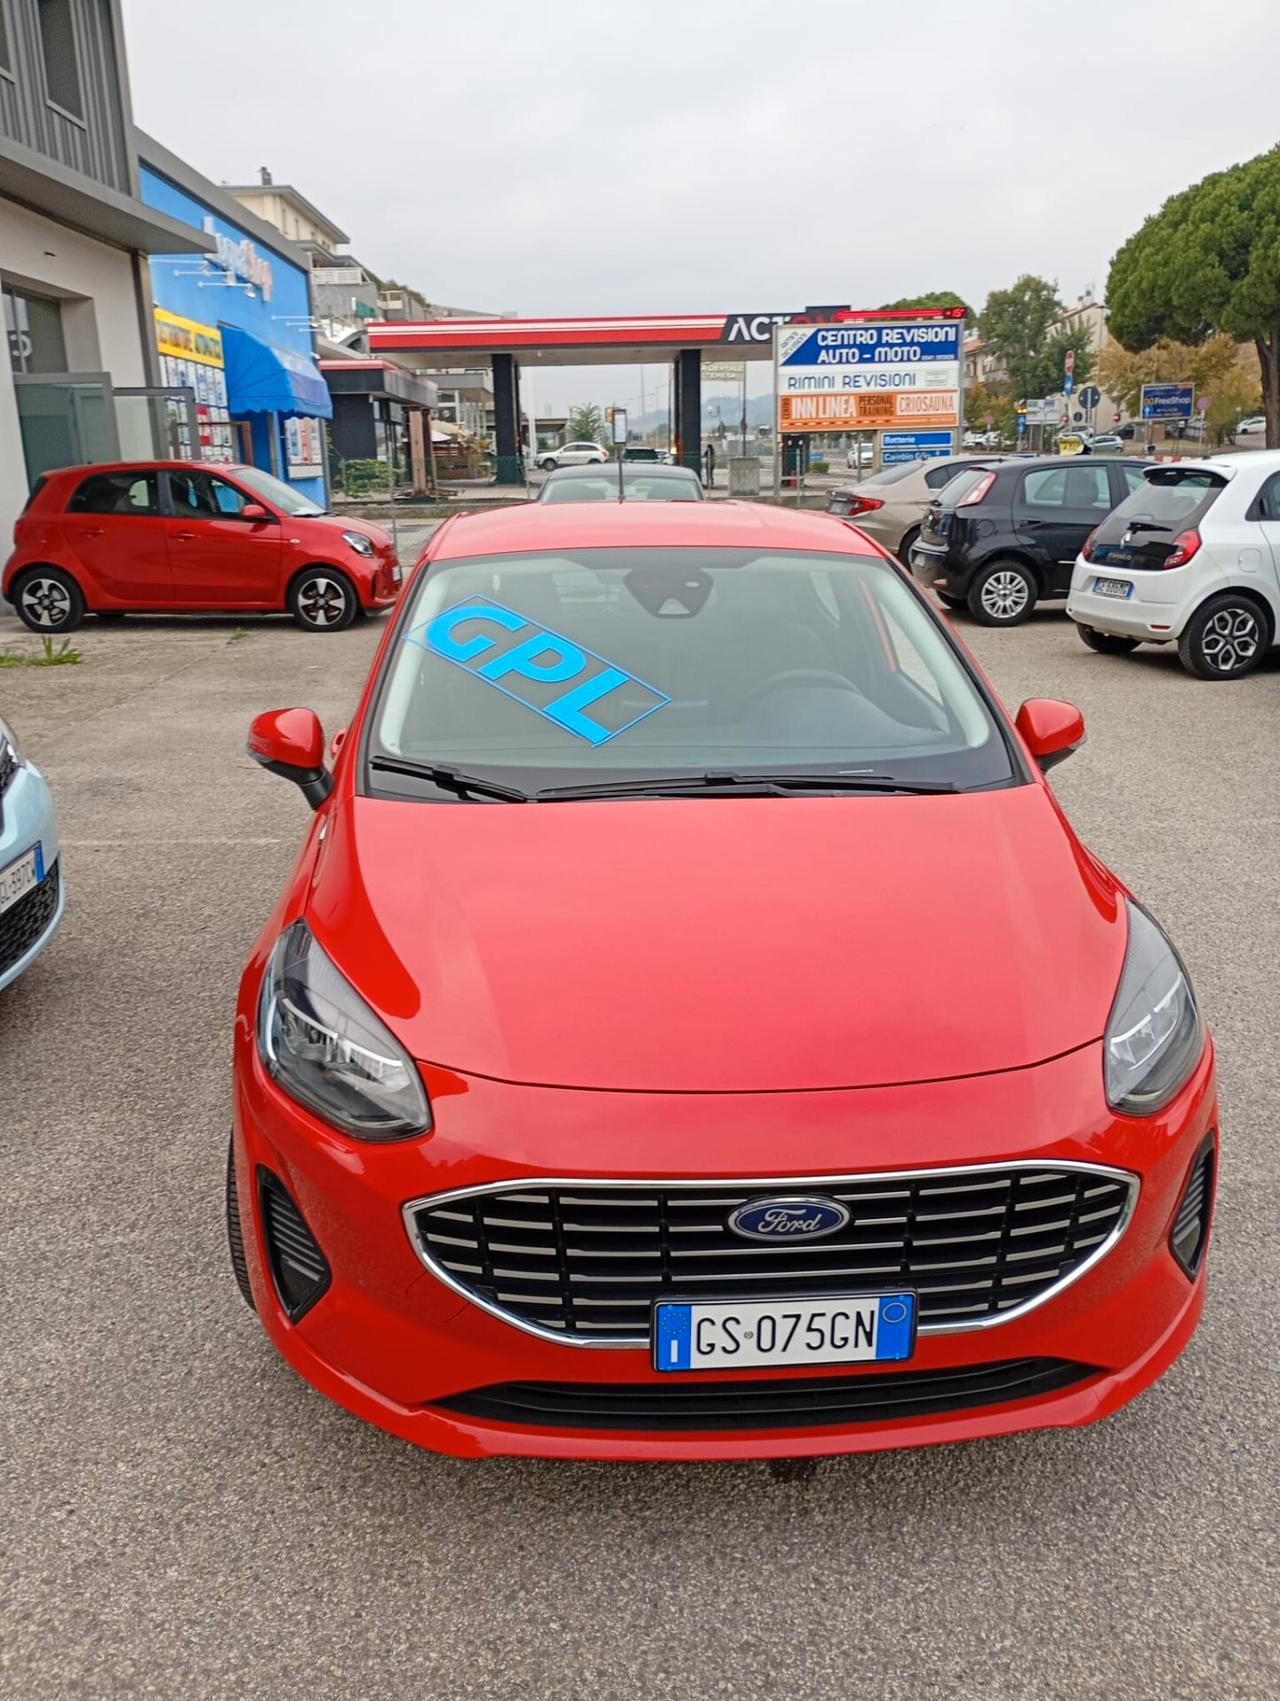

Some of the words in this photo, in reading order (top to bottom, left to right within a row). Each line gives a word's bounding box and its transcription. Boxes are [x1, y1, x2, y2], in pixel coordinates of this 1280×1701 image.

[816, 329, 877, 346] CENTRO
[881, 327, 956, 344] REVISIONI
[816, 348, 859, 364] AUTO
[874, 346, 921, 362] MOTO
[787, 376, 835, 390] RIMINI
[842, 373, 916, 388] REVISIONI
[818, 396, 857, 418] LINEA
[859, 395, 893, 407] PERSONAL
[899, 394, 954, 413] CRIOSAUNA
[859, 406, 894, 417] TRAINING
[884, 435, 916, 444] Batterie
[884, 451, 914, 462] Cambio
[425, 605, 629, 744] GPL
[757, 1209, 820, 1233] Ford
[696, 1317, 741, 1355] GS
[756, 1309, 875, 1353] 075GN
